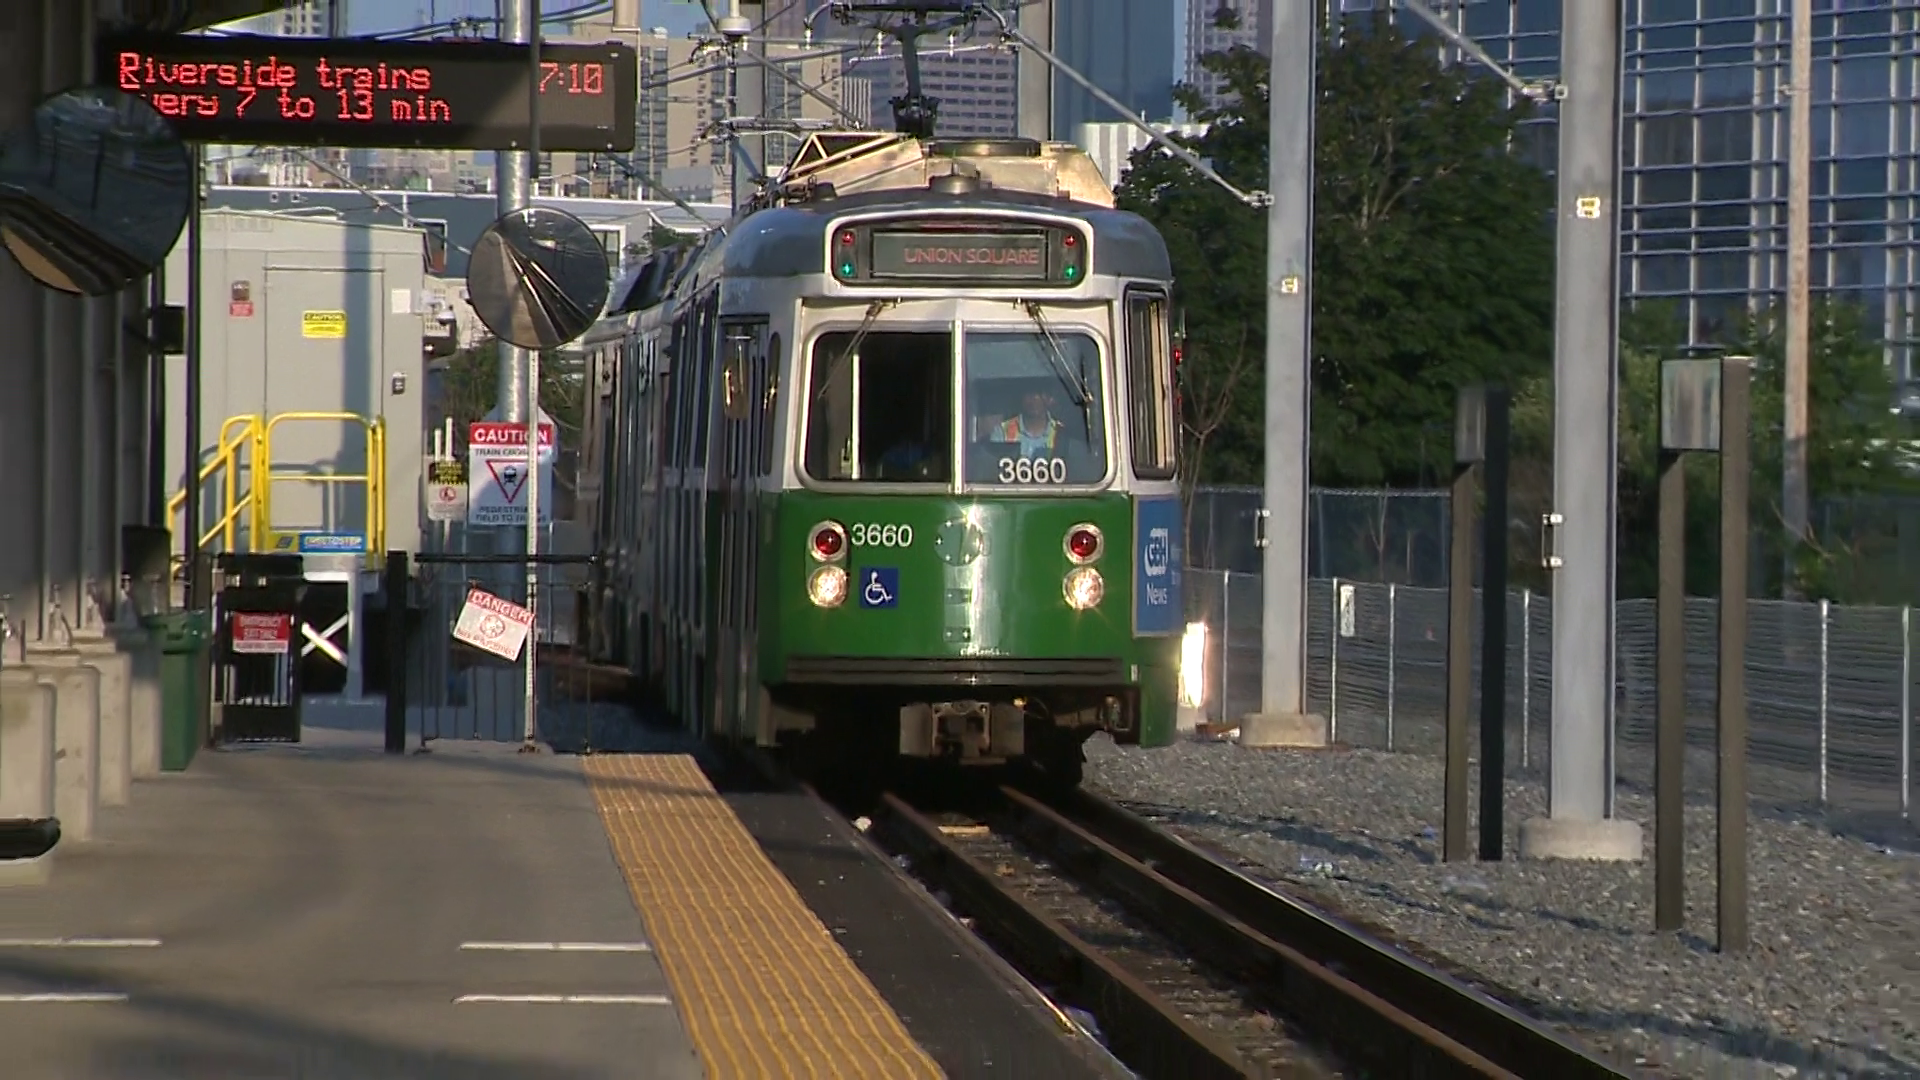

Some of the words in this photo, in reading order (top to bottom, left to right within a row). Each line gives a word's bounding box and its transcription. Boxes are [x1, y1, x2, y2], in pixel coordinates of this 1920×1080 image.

[119, 52, 296, 89] Riverside
[316, 57, 431, 90] trains
[538, 62, 604, 94] 7:10
[236, 86, 257, 117] 7
[277, 88, 315, 118] to
[337, 88, 374, 119] 13
[391, 95, 450, 121] min
[904, 247, 962, 264] UNION
[966, 248, 1040, 265] SQUARE
[999, 457, 1066, 483] 3660
[850, 523, 913, 547] 3660
[470, 591, 532, 625] DANGER
[1146, 582, 1168, 606] News
